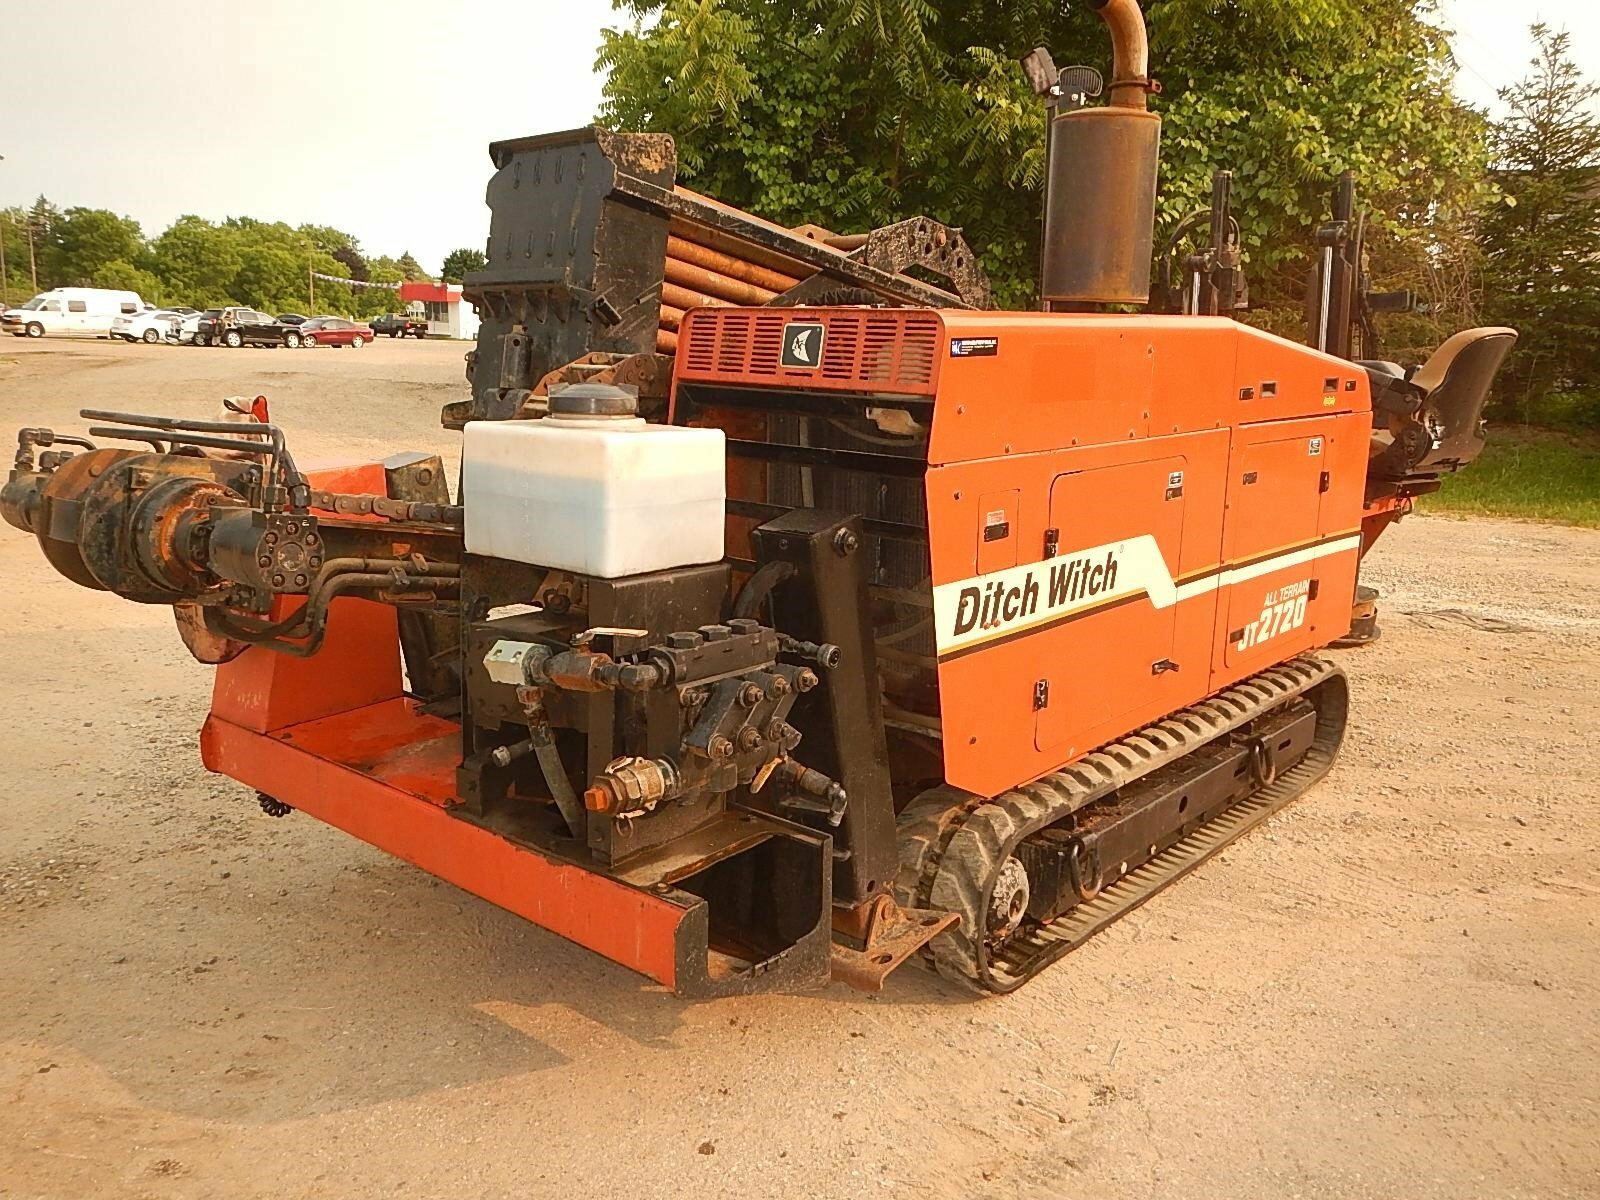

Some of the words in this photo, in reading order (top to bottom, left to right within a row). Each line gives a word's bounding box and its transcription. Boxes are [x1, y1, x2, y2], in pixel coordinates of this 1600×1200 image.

[953, 572, 1039, 636] Ditch
[1048, 551, 1118, 608] Witch
[1263, 590, 1278, 607] ALL
[1280, 578, 1310, 602] TERRAIN
